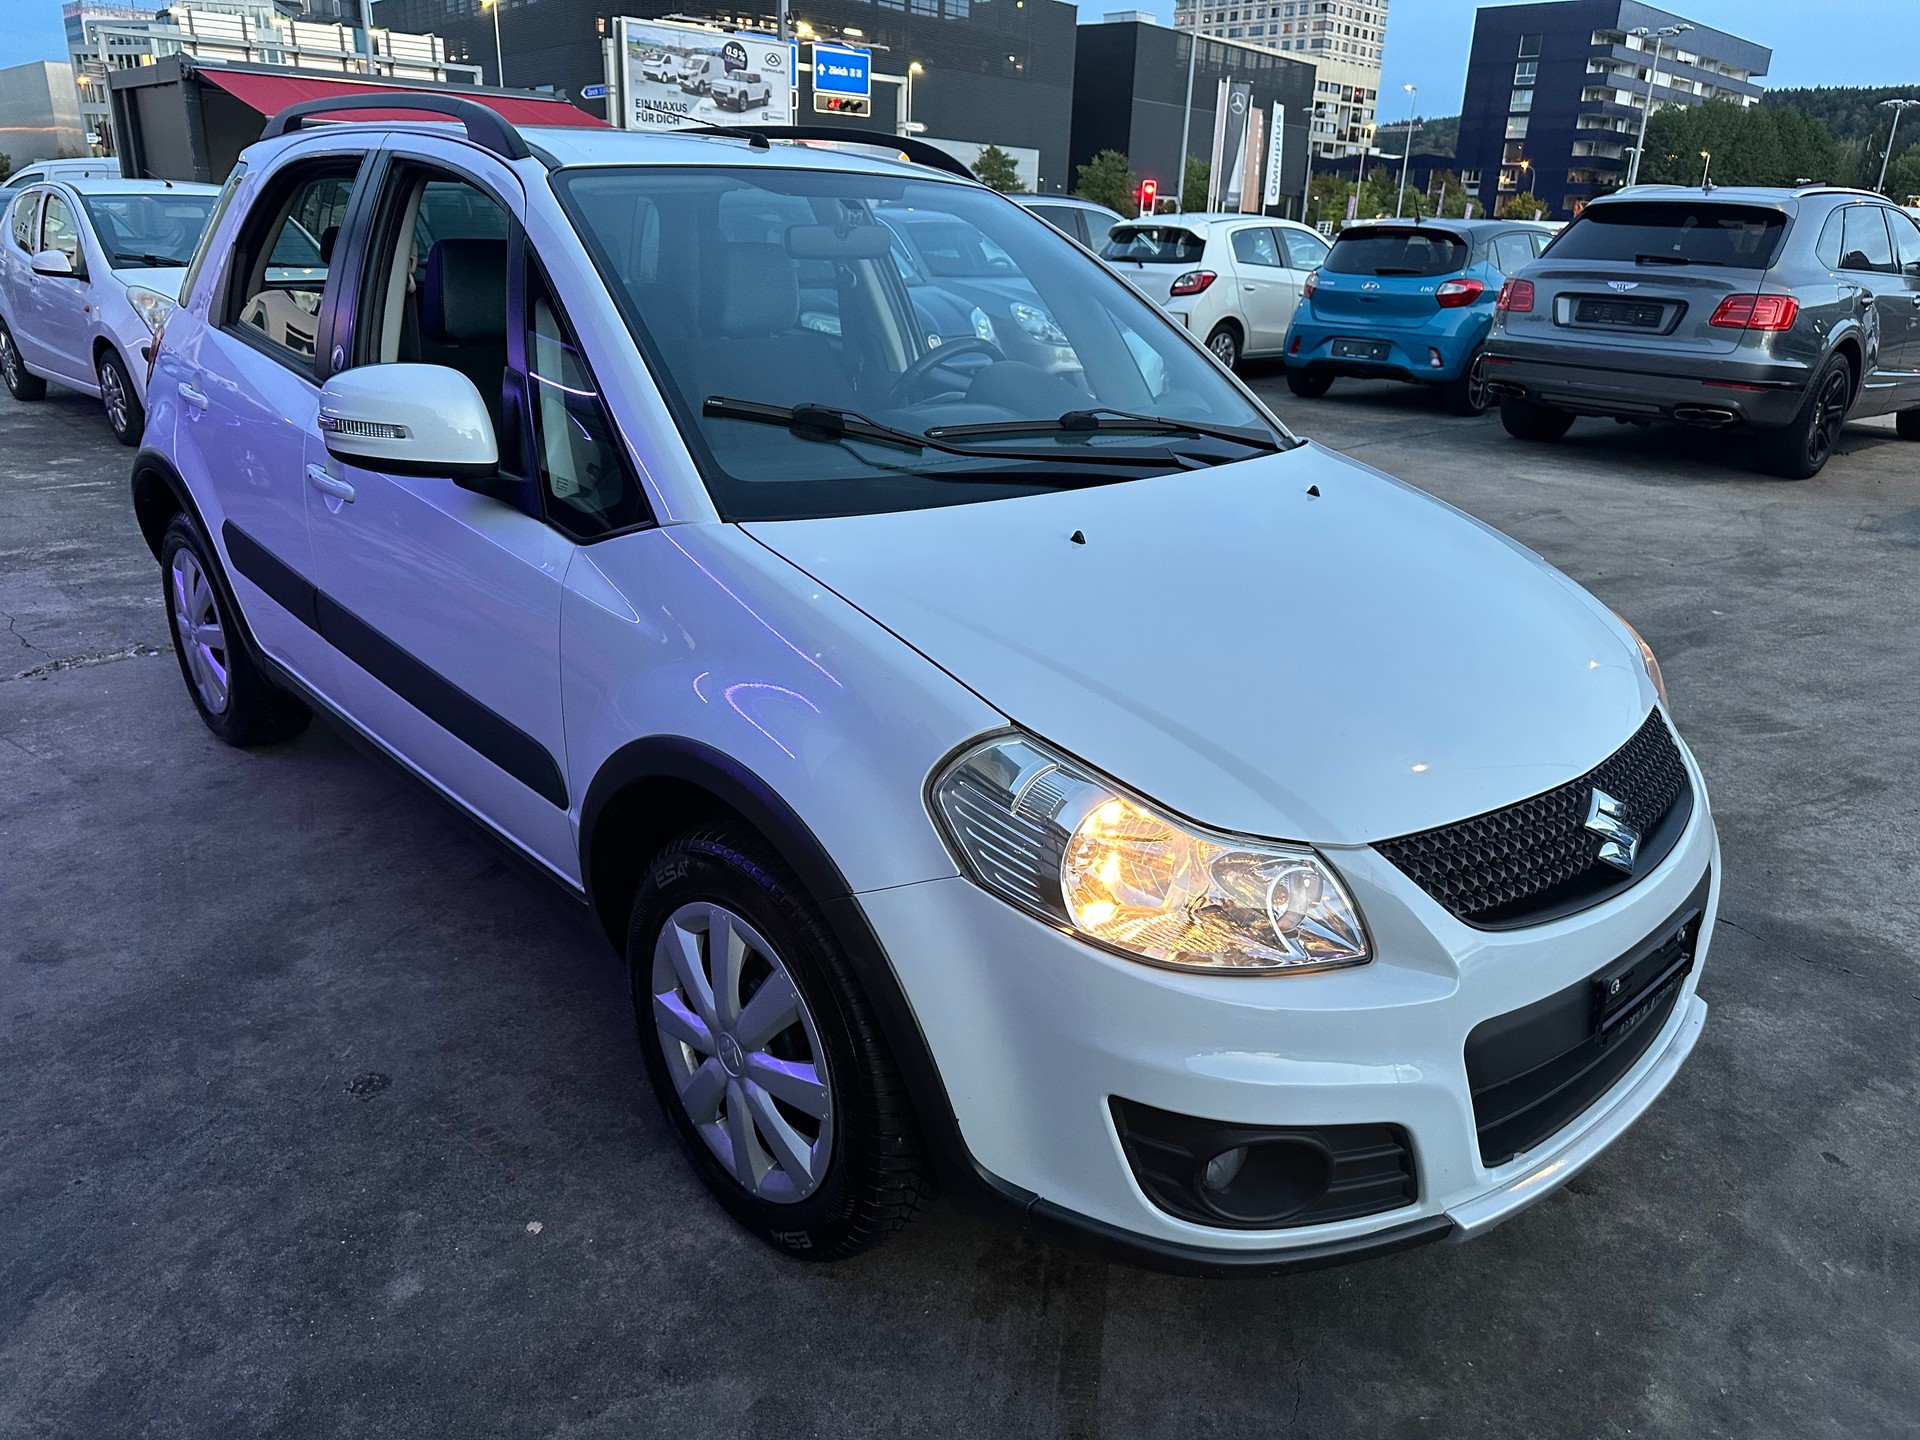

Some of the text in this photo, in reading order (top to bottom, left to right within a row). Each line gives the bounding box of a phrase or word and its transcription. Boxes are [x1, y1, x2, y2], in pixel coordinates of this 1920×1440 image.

[828, 65, 848, 76] Zürich
[635, 98, 652, 109] EIN
[653, 100, 688, 113] MAXUS
[635, 109, 680, 125] FÜR DICH
